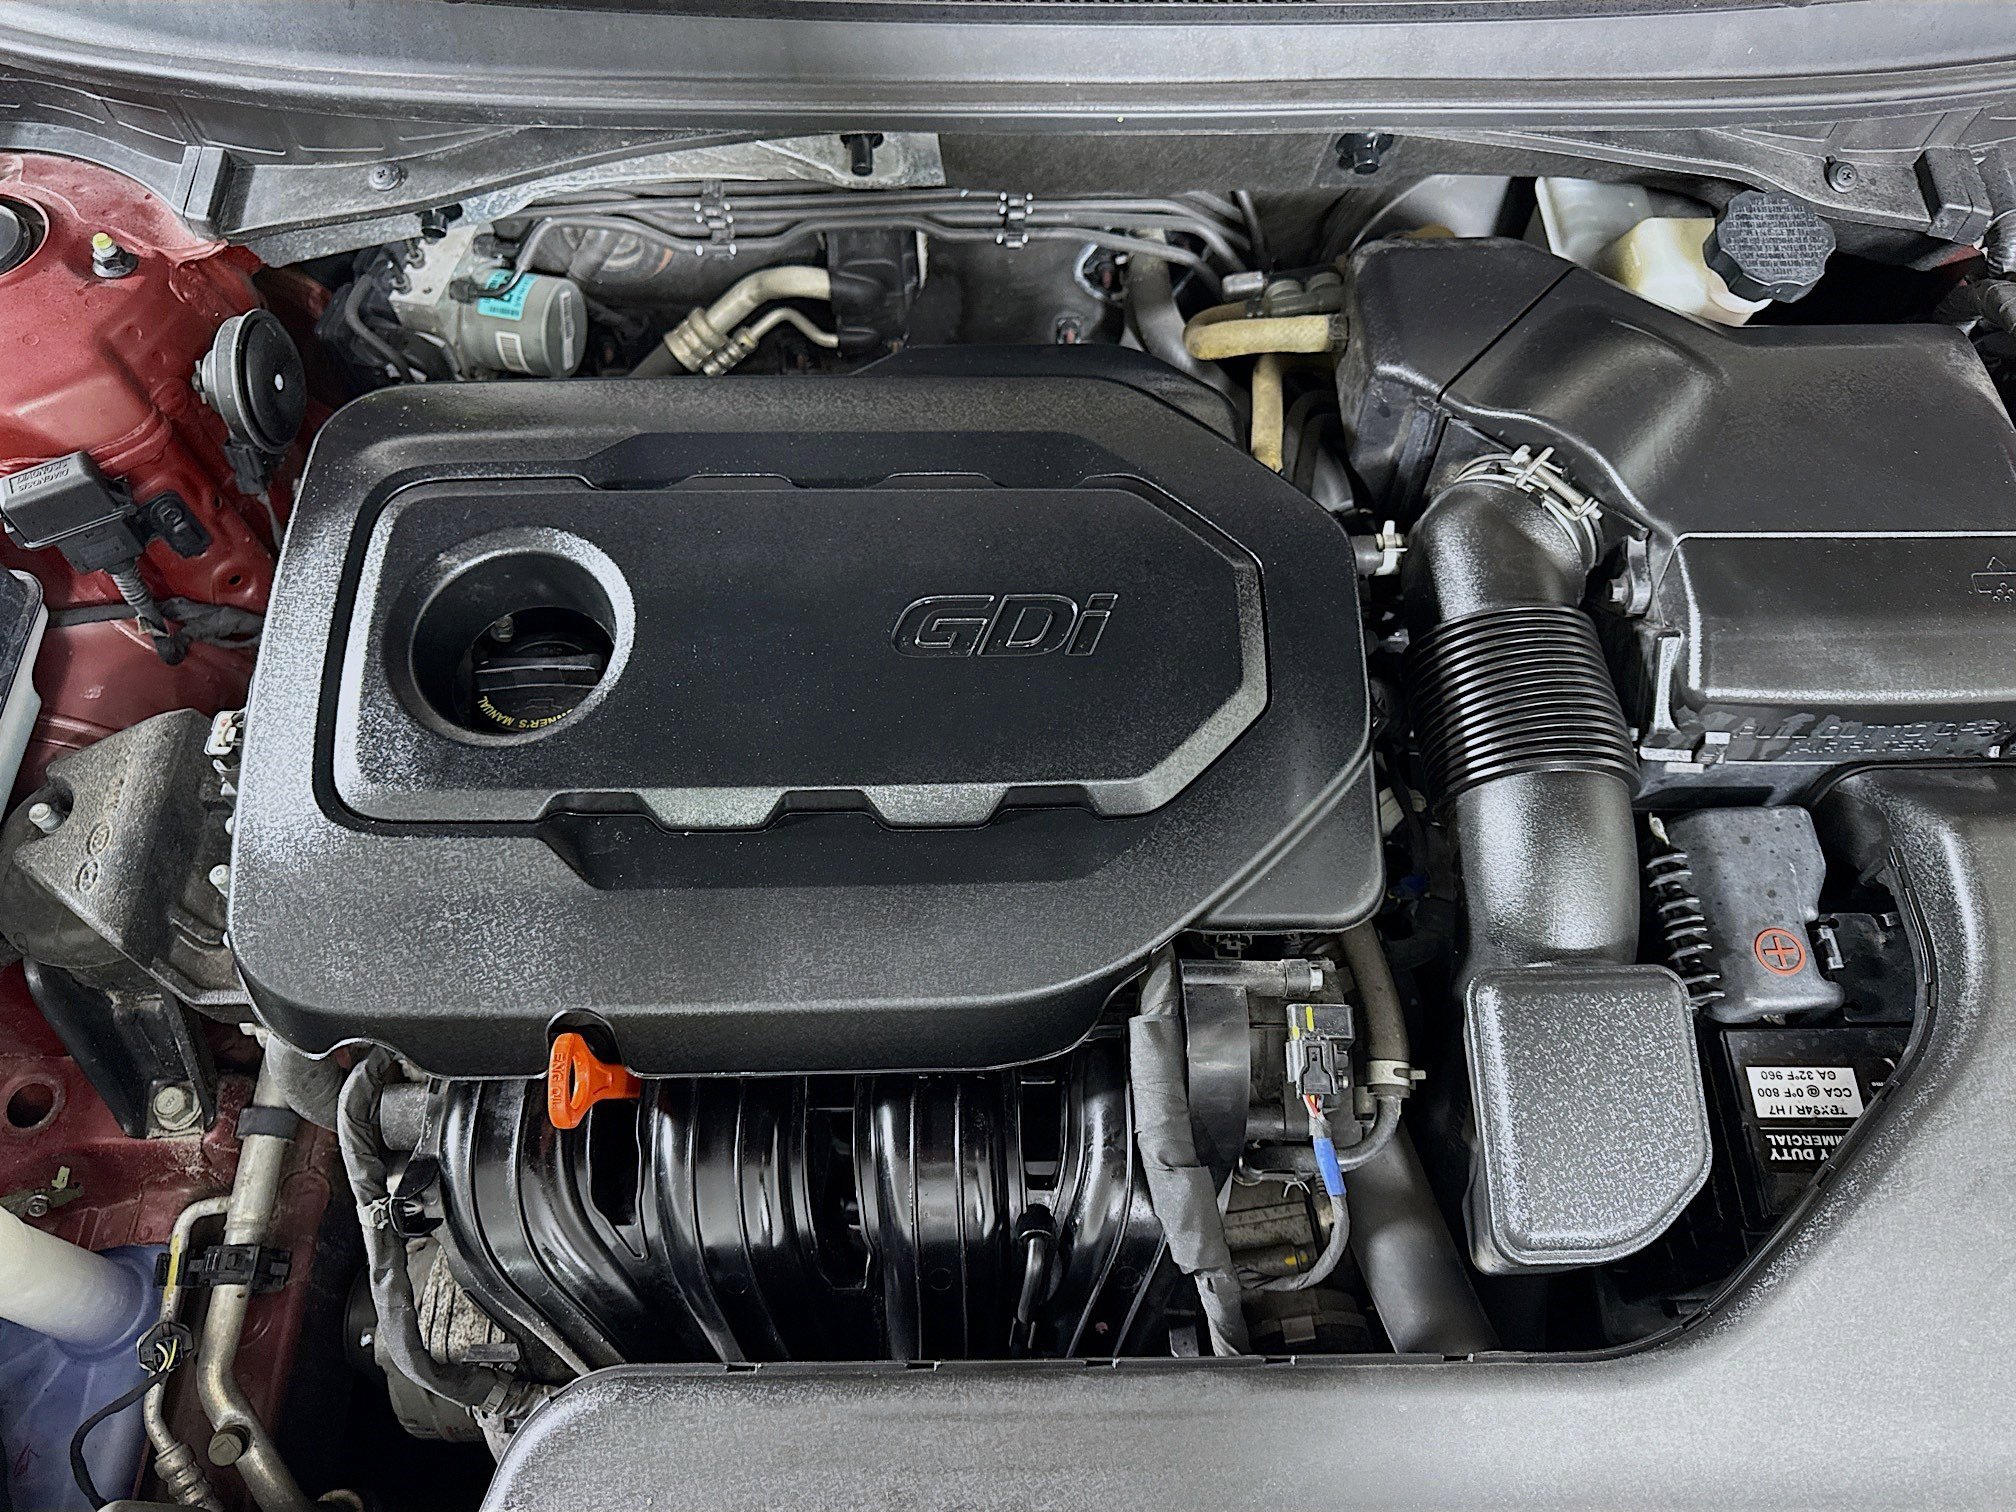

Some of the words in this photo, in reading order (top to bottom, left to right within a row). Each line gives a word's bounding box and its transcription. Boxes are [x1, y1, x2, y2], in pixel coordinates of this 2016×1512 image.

[891, 593, 1119, 658] GDi
[477, 695, 515, 726] MANUAL
[552, 1052, 566, 1081] ENG
[1761, 1070, 1783, 1080] 960
[551, 1086, 562, 1109] OIL
[1757, 1087, 1780, 1098] 800
[1824, 1087, 1852, 1098] CCA
[1766, 1134, 1845, 1146] MMERCIAL
[1770, 1148, 1815, 1161] DUTY
